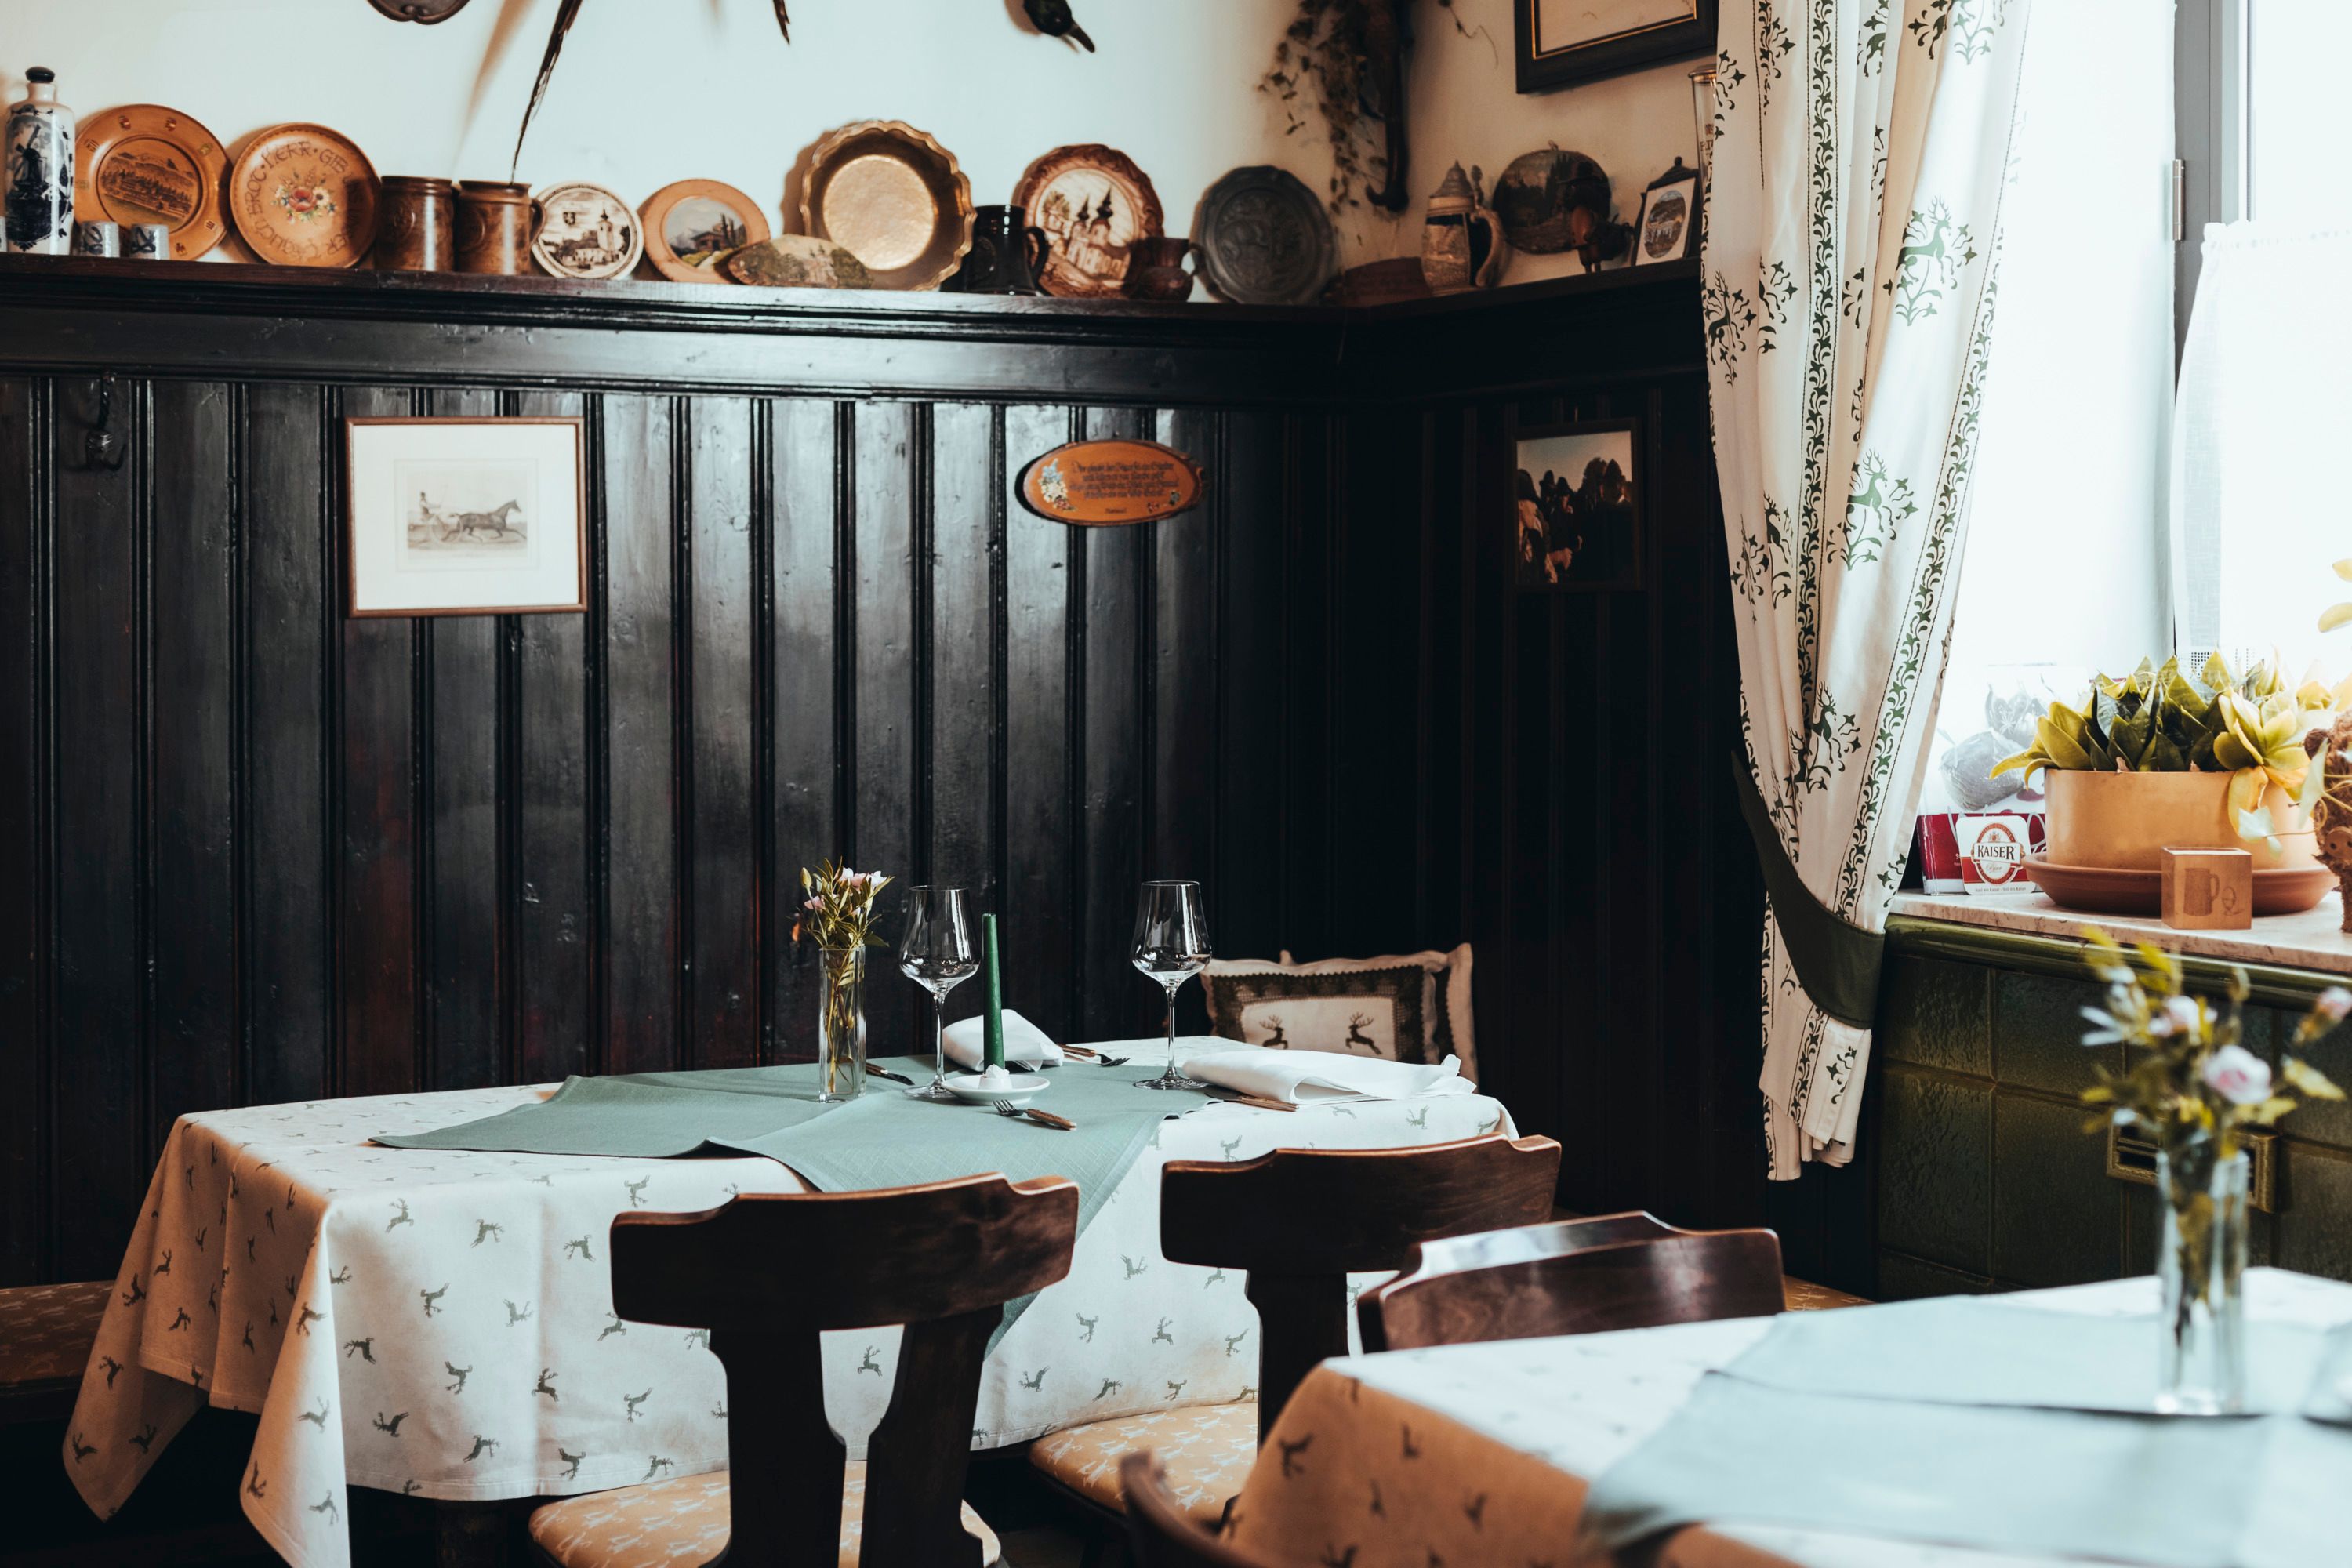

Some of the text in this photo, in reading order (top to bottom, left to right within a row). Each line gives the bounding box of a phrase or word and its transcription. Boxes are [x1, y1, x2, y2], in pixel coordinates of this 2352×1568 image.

[261, 141, 313, 169] HERR
[319, 148, 350, 174] GIB
[1977, 845, 2015, 861] KAISER
